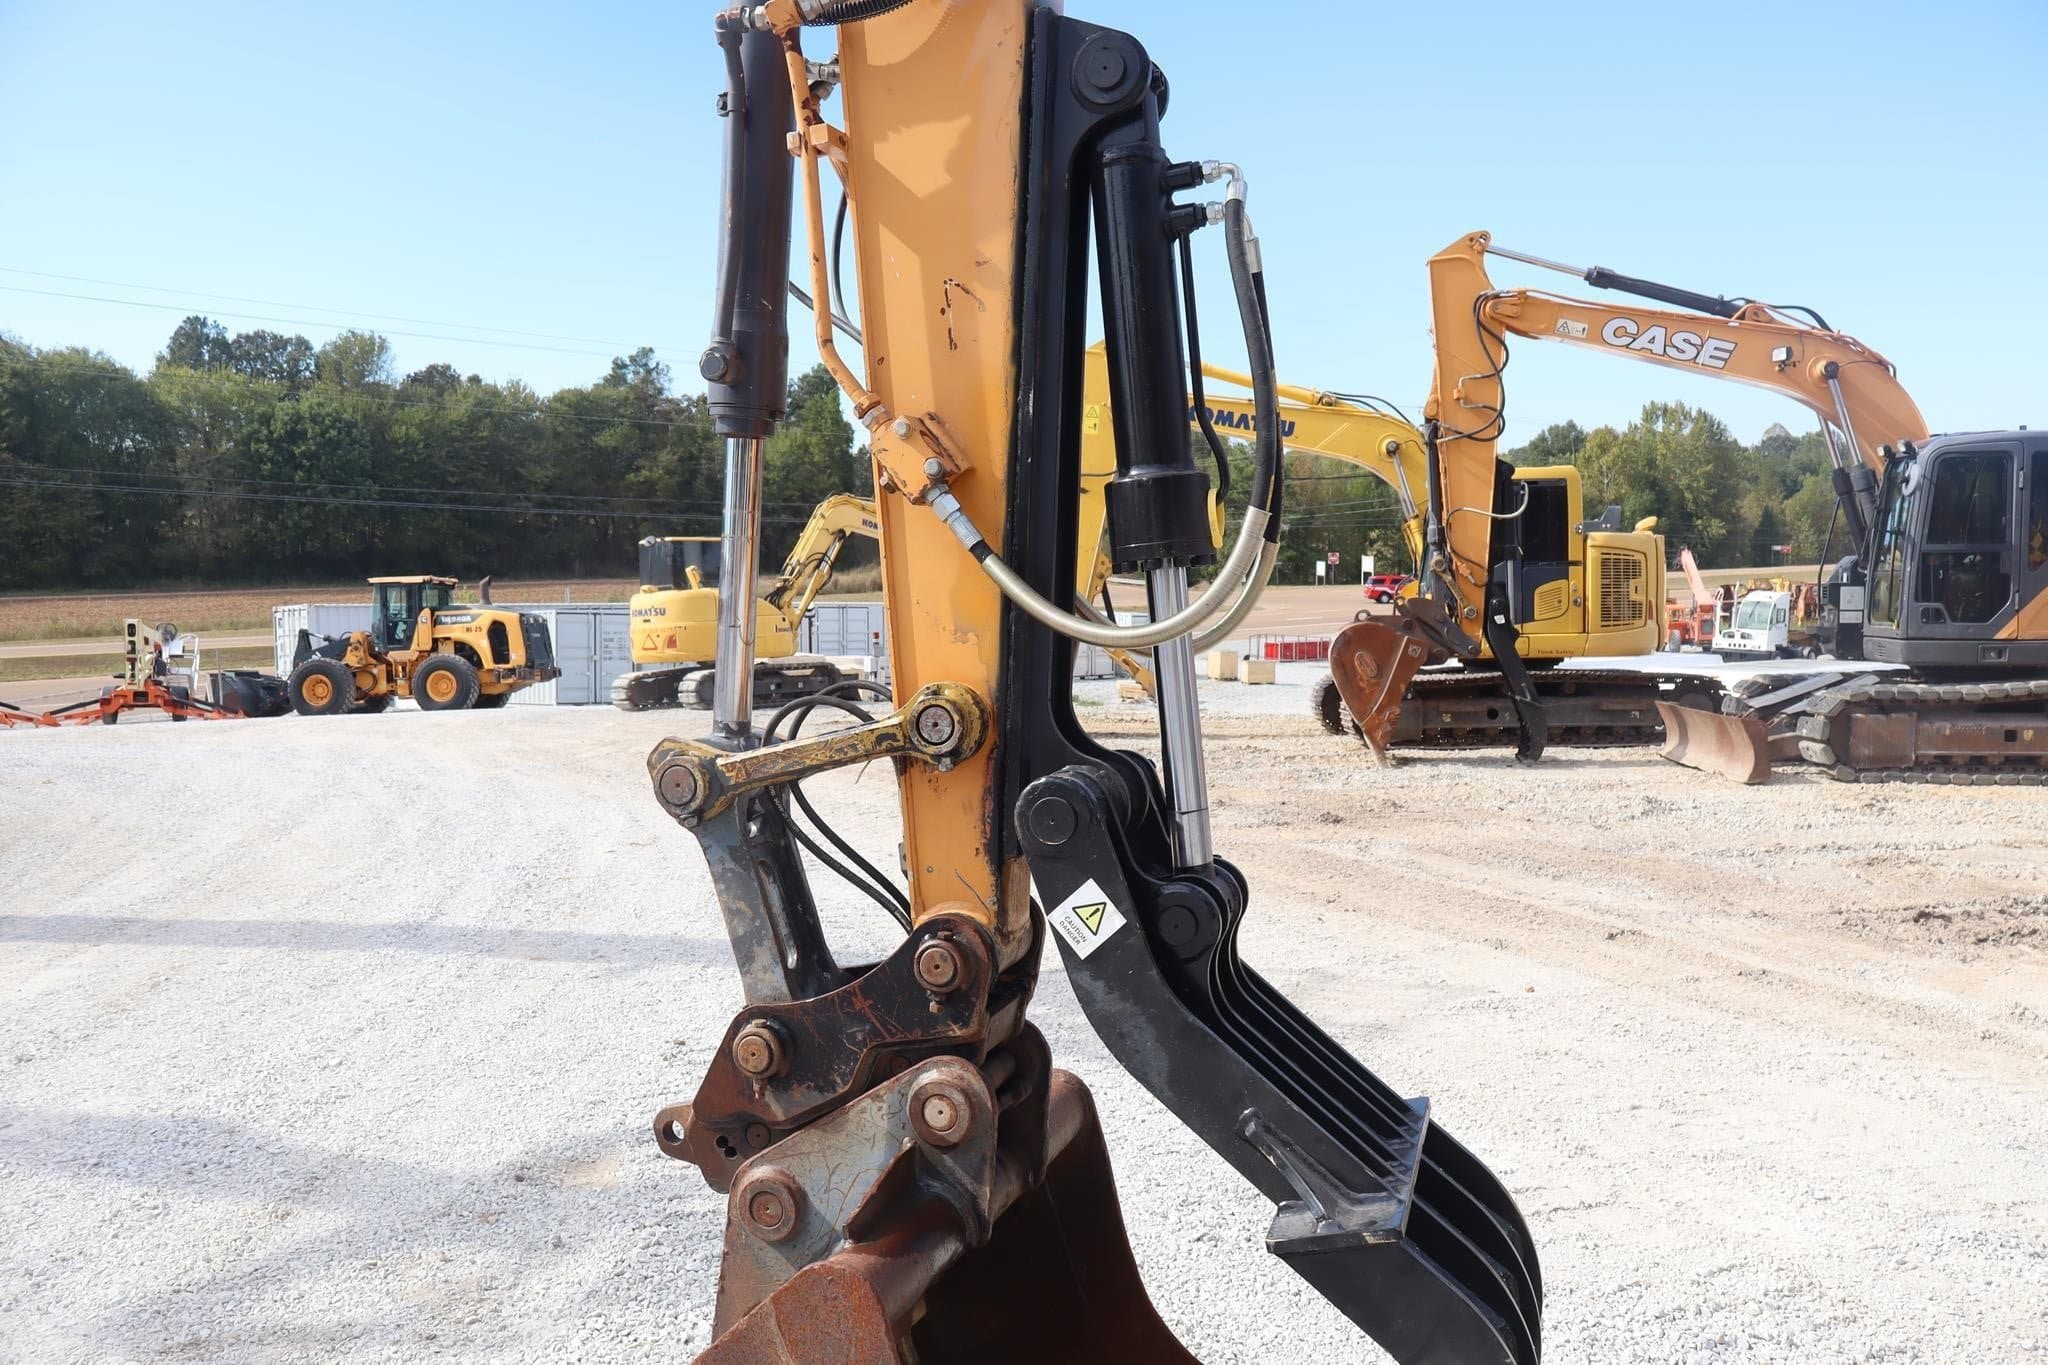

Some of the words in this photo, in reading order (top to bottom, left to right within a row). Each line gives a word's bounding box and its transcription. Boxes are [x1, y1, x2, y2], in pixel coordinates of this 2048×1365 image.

[1601, 316, 1737, 369] CASE
[1059, 920, 1081, 946] DANGER
[1064, 915, 1088, 943] CAUTION
